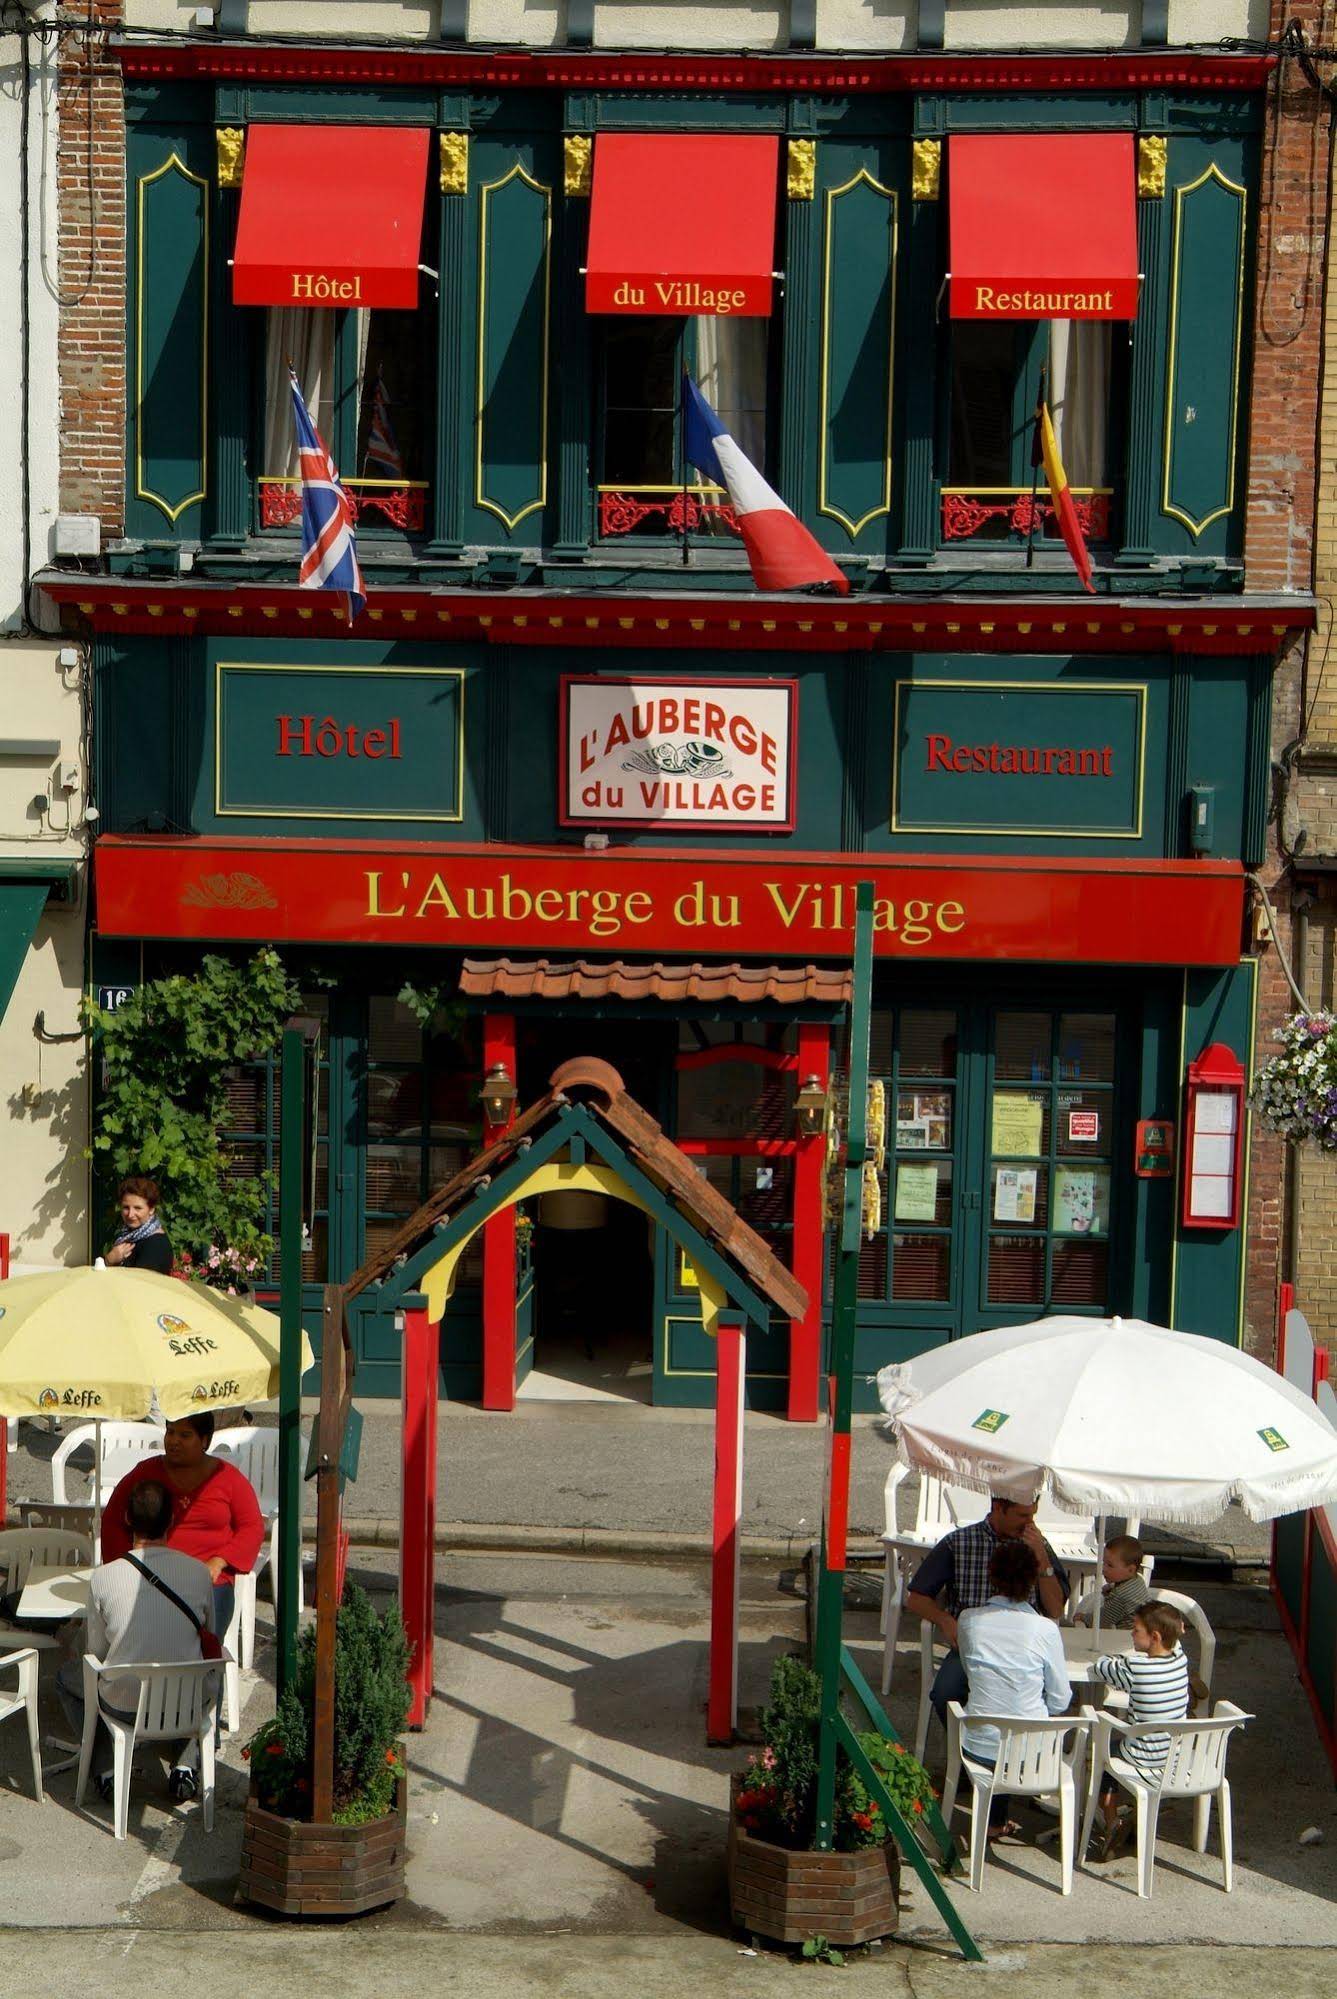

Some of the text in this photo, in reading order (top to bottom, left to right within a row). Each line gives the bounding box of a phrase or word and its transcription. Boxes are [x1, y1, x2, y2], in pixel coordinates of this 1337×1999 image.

[291, 274, 363, 300] Hôtel
[613, 281, 746, 313] du Village
[975, 285, 1113, 312] Restaurant
[276, 715, 403, 760] Hôtel
[580, 697, 778, 777] L'AUBERGE
[924, 733, 1114, 777] Restaurant
[581, 781, 776, 812] du VILLAGE
[364, 871, 654, 937] L'Auberge
[673, 880, 741, 928] du
[106, 990, 127, 1010] 16
[168, 1336, 218, 1356] Leffe
[61, 1387, 102, 1408] Leffe
[209, 1380, 240, 1399] Leffe
